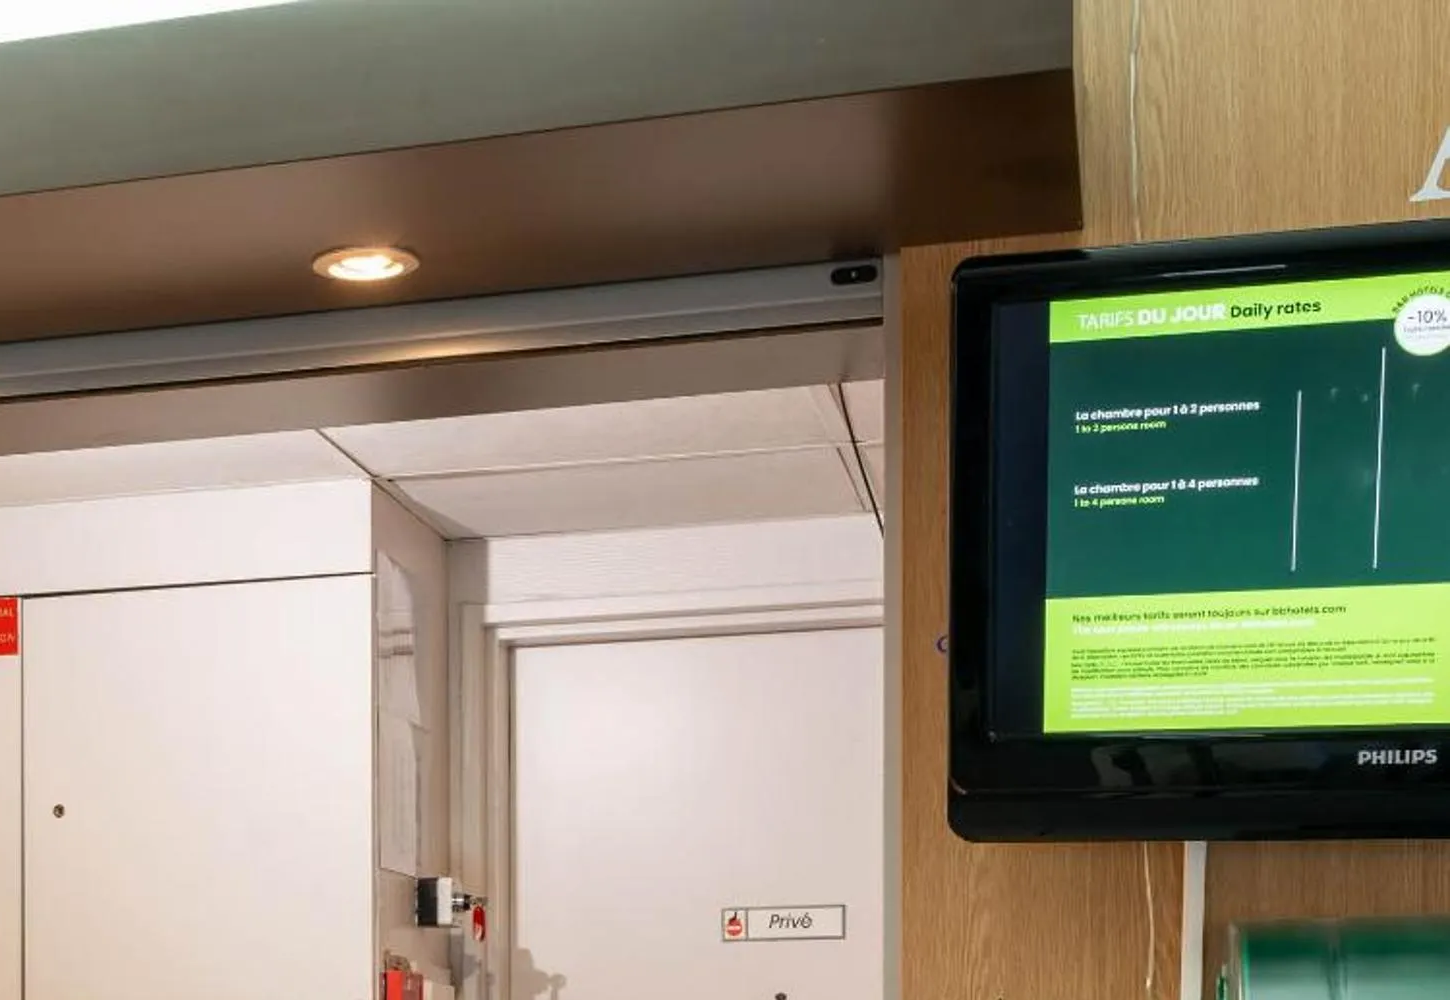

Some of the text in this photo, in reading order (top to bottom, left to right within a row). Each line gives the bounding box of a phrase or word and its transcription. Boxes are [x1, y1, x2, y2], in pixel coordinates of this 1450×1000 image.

[1077, 301, 1322, 331] TARIFS DU JOUR Daily rates
[1407, 309, 1447, 323] -10%
[1075, 411, 1090, 421] La
[1090, 407, 1143, 421] chambre
[1144, 406, 1172, 420] pour
[1173, 405, 1179, 415] 1
[1189, 403, 1199, 414] 2
[1199, 401, 1261, 416] personnes
[1081, 423, 1092, 432] to
[1092, 422, 1100, 432] 2
[1074, 485, 1088, 496] La
[1088, 481, 1142, 496] chambre
[1142, 480, 1170, 494] pour
[1170, 479, 1177, 490] 1
[1187, 479, 1198, 489] 4
[1198, 476, 1260, 491] personnes
[1079, 498, 1091, 508] to
[1091, 497, 1099, 506] 4
[1357, 749, 1439, 766] PHILIPS
[768, 911, 814, 930] Privé
